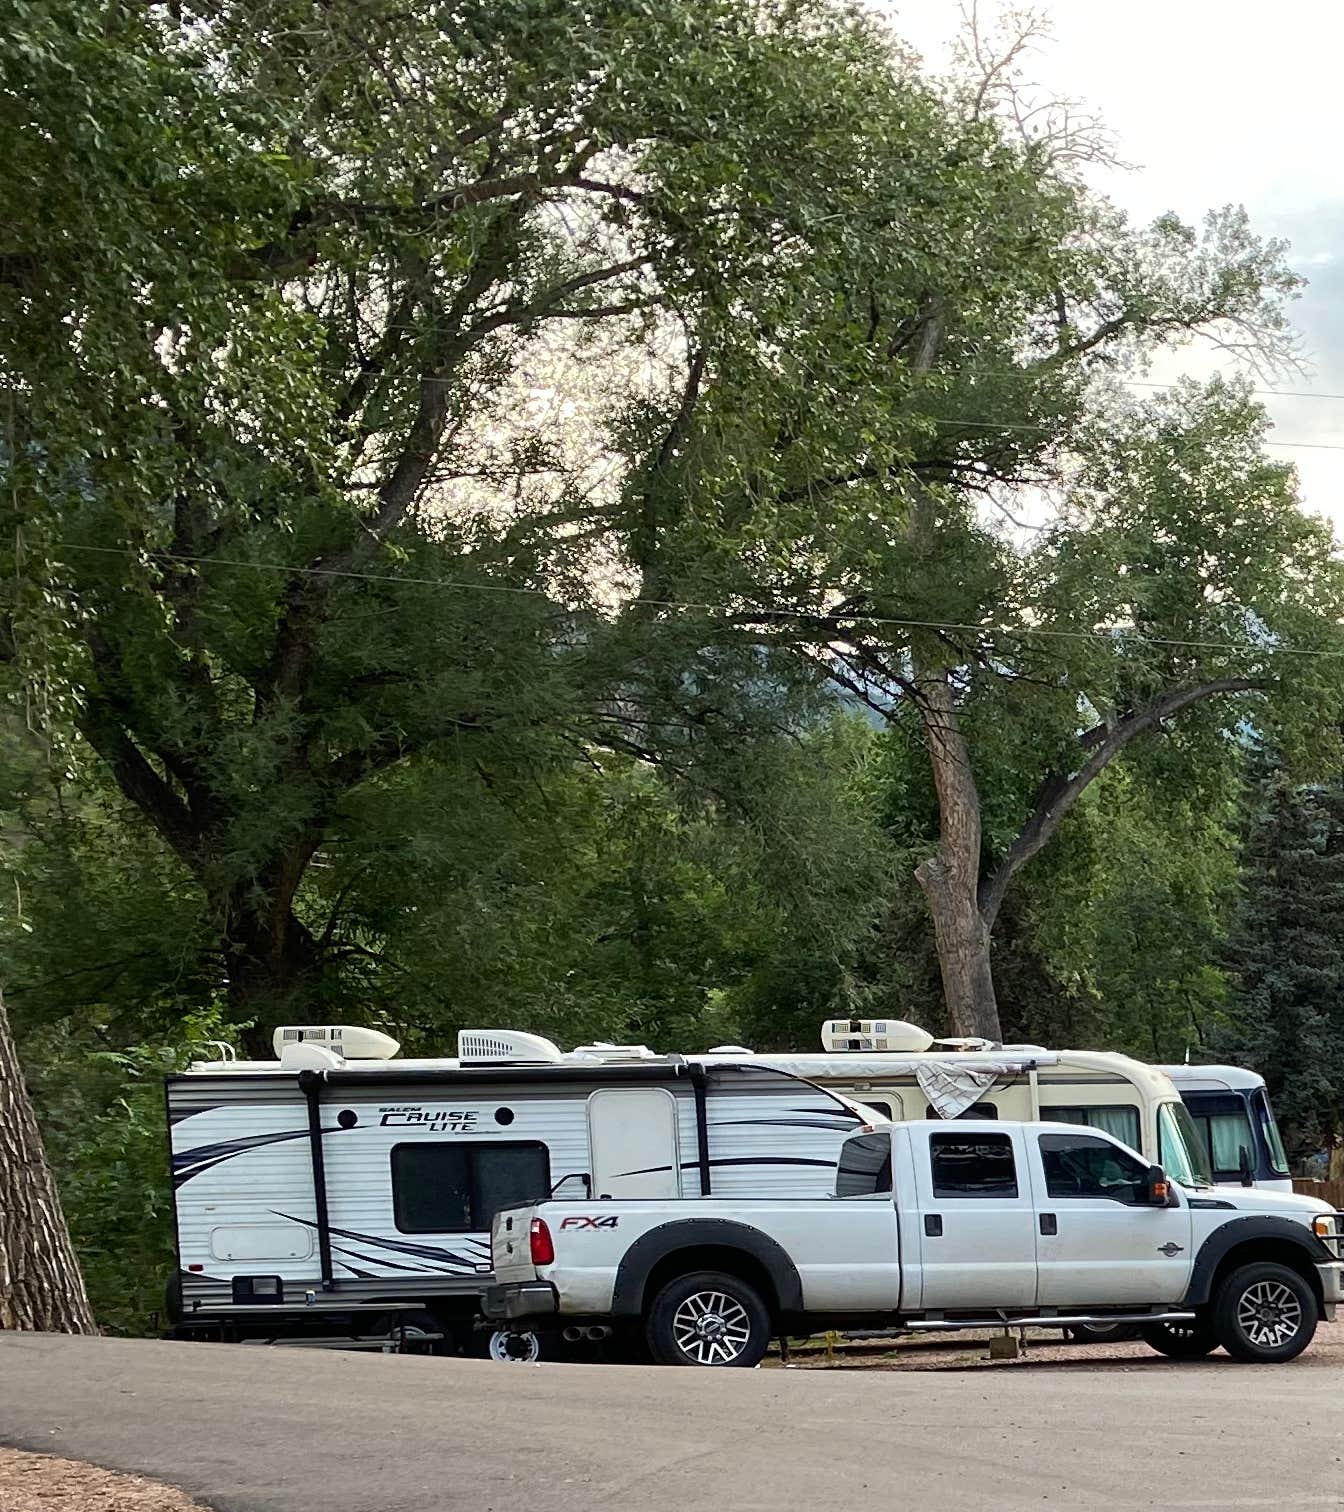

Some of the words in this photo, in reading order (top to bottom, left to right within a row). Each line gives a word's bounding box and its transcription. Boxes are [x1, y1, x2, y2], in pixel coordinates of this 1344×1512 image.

[380, 1111, 479, 1127] CRUISE
[429, 1122, 478, 1132] LITE
[560, 1216, 619, 1229] FX4
